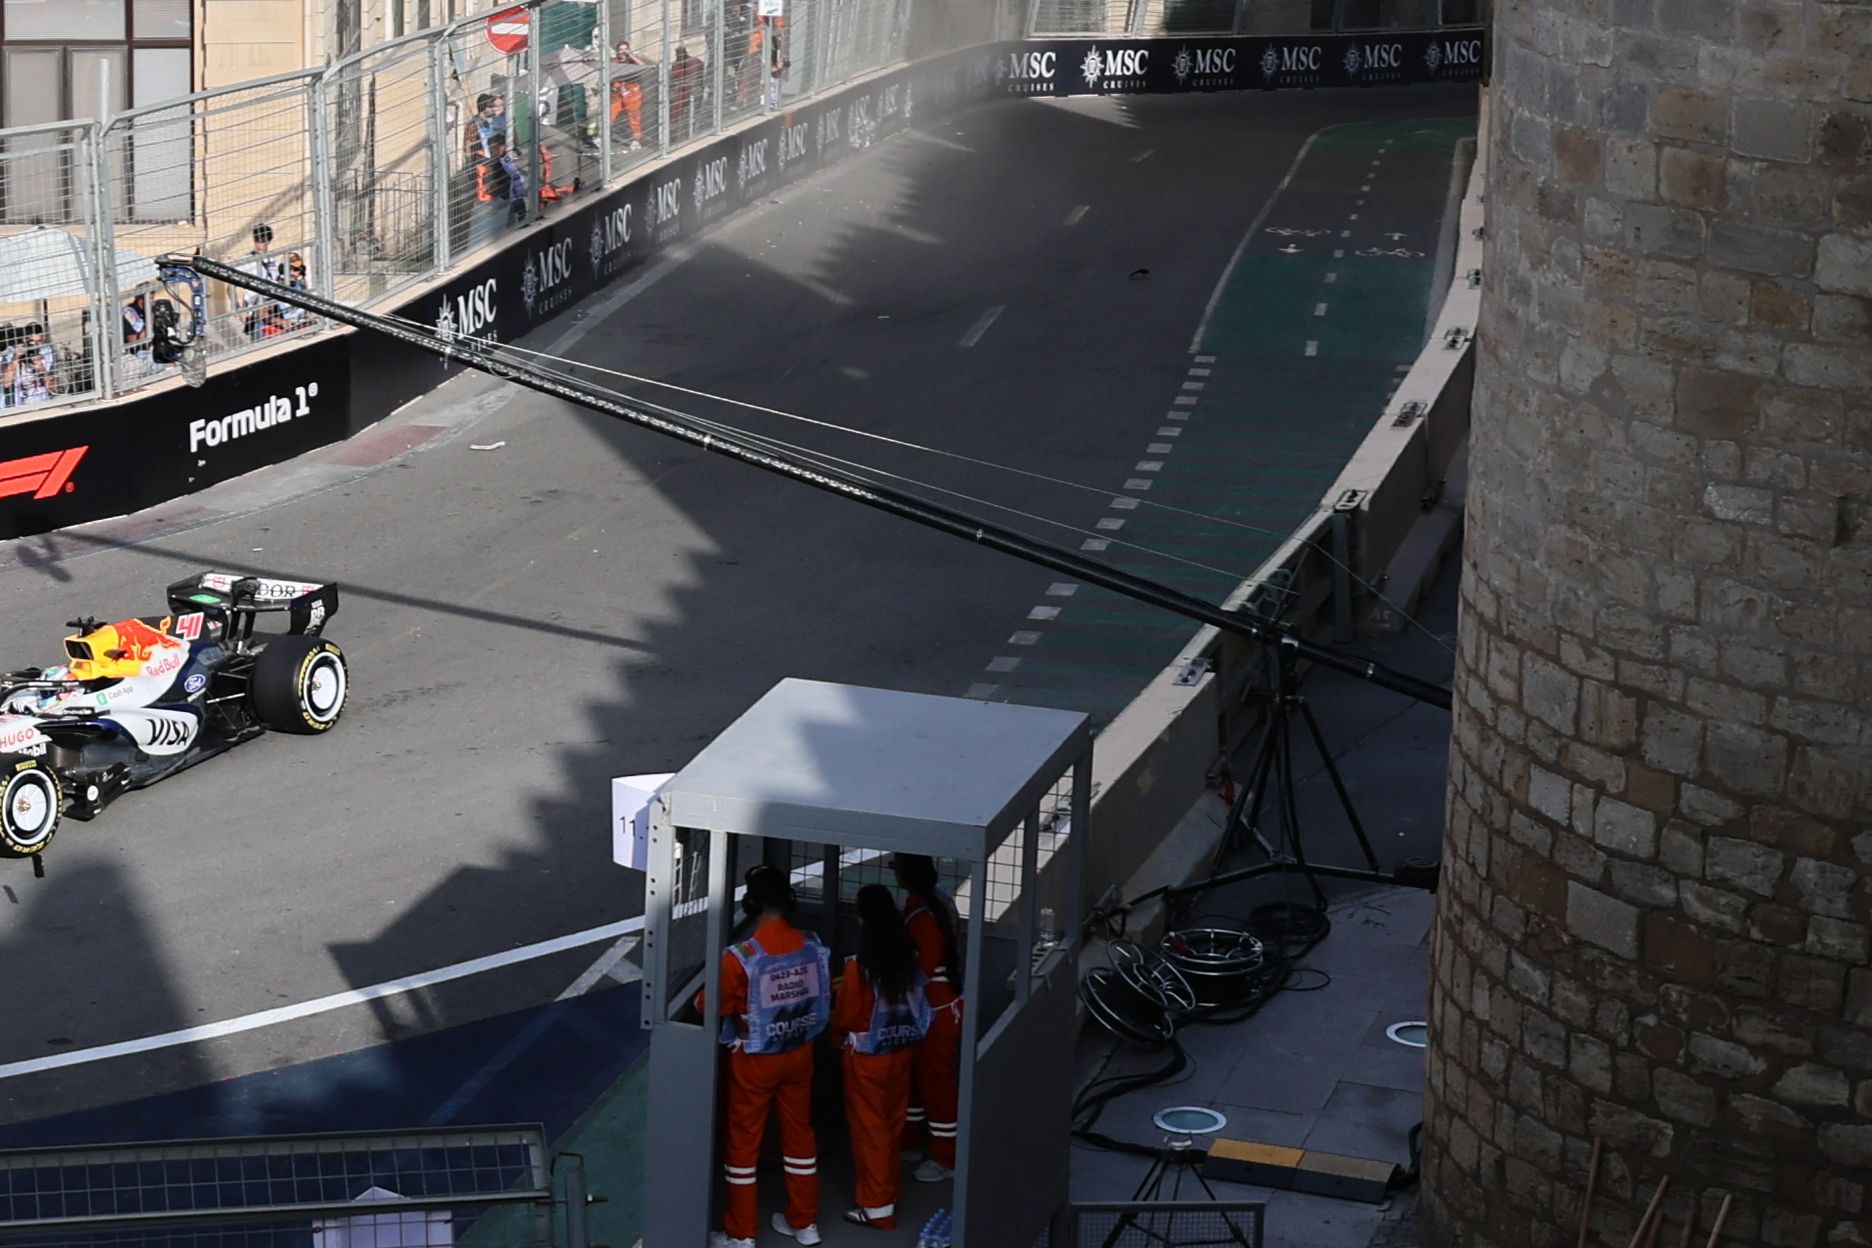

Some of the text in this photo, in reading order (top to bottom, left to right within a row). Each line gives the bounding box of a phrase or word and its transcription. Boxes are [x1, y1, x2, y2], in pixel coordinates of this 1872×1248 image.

[1104, 50, 1149, 76] MSC
[1194, 48, 1236, 73] MSC
[1281, 46, 1322, 71] MSC
[1363, 44, 1402, 68] MSC
[1444, 40, 1481, 64] MSC
[1009, 51, 1057, 79] MSC
[1008, 82, 1055, 92] CRUISES
[1103, 80, 1147, 89] CRUISES
[748, 138, 768, 179] MSC
[705, 156, 728, 200] MSC
[657, 178, 681, 224] MSC
[605, 204, 632, 255] MSC
[540, 238, 573, 293] MSC
[457, 278, 497, 340] MSC
[189, 395, 292, 452] Formula
[257, 583, 296, 598] DOR
[175, 612, 205, 641] 41
[146, 653, 181, 678] Red Bull
[146, 718, 190, 746] VISA
[777, 980, 804, 991] RADIO
[766, 1013, 817, 1036] COURSE
[879, 1024, 918, 1040] COURS
